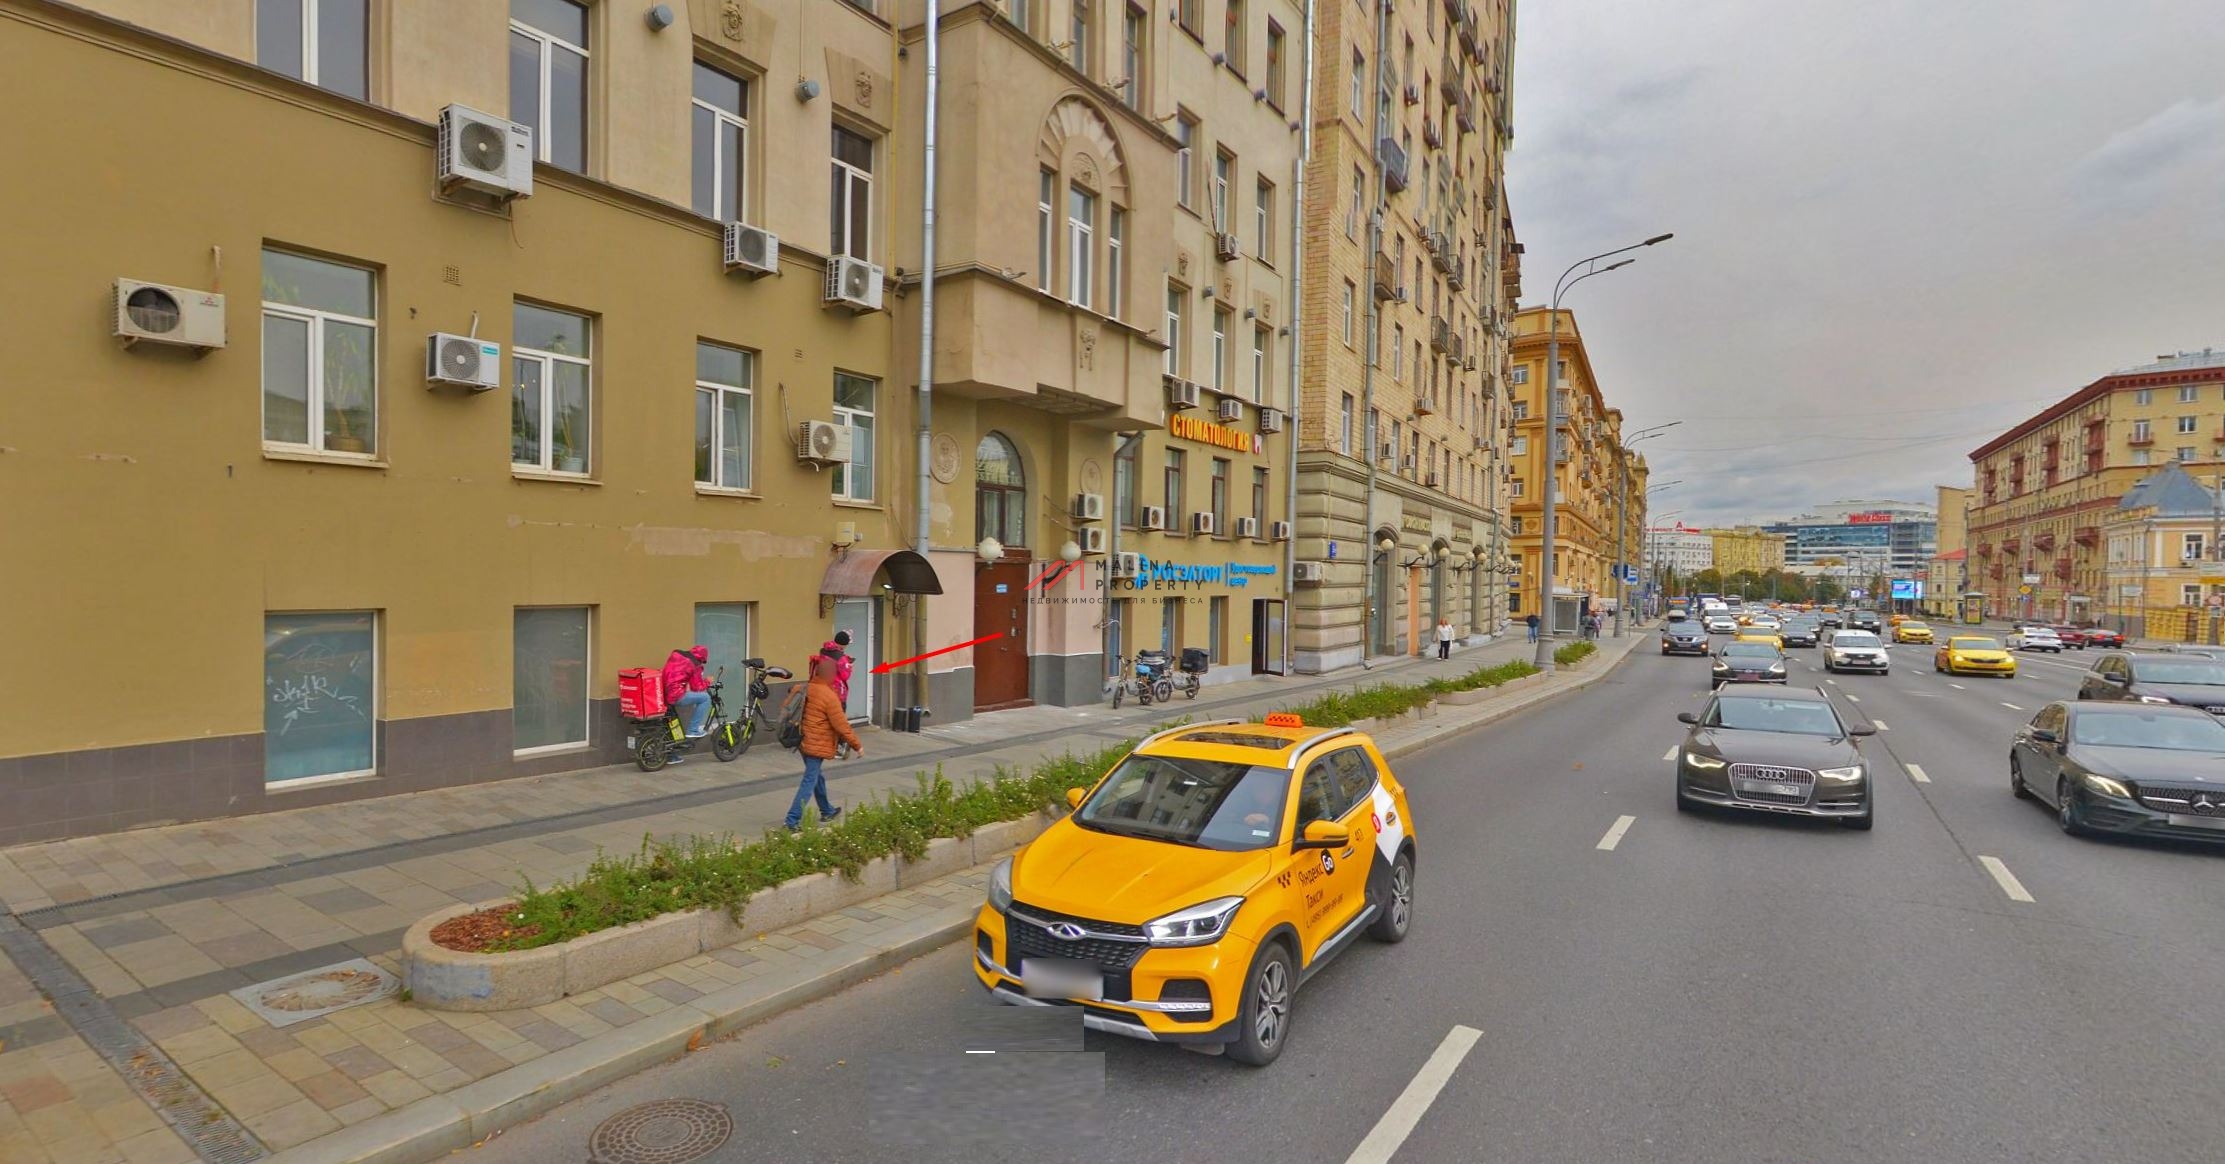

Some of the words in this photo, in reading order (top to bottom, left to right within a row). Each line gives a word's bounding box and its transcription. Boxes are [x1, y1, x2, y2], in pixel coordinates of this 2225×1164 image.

[1171, 413, 1250, 453] СТОМАТОЛОГИЯ
[1298, 863, 1324, 888] Яндекс
[1321, 854, 1334, 872] Go
[1305, 889, 1324, 912] Такси
